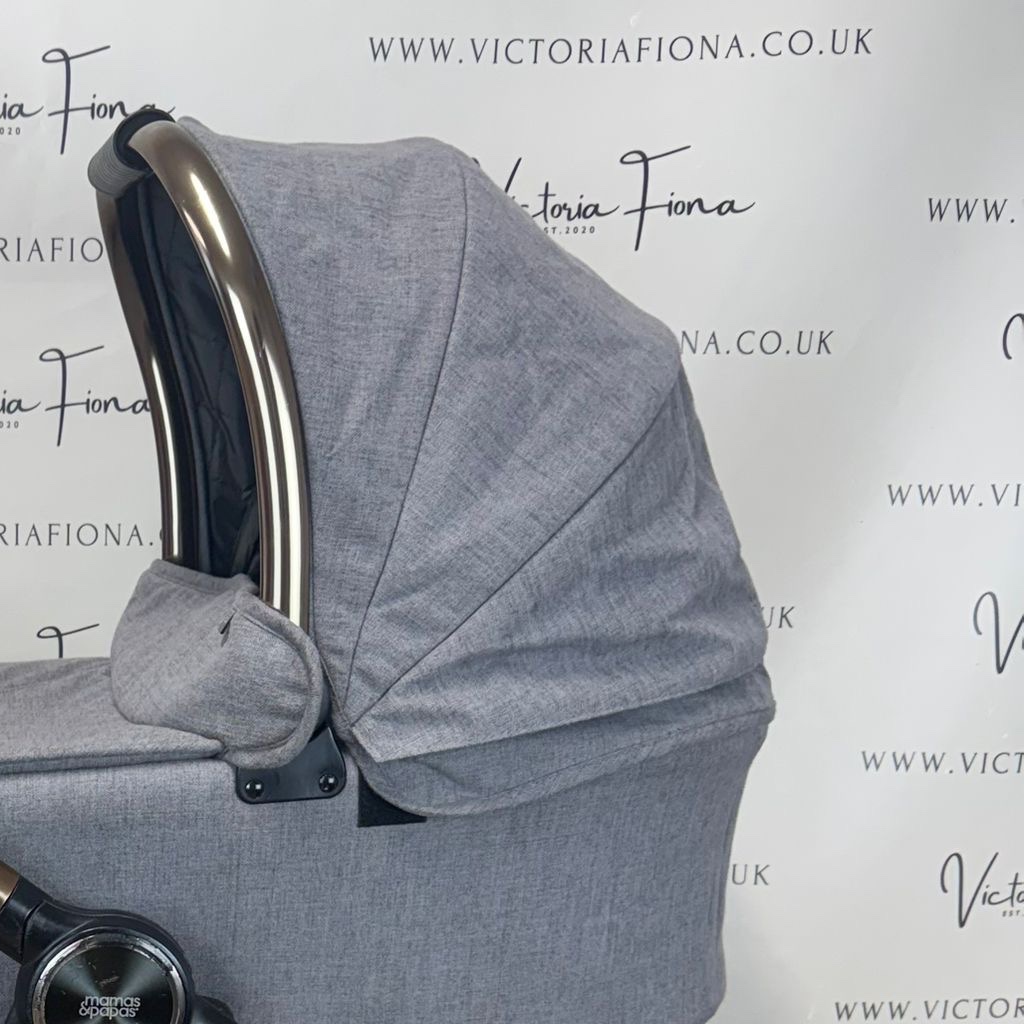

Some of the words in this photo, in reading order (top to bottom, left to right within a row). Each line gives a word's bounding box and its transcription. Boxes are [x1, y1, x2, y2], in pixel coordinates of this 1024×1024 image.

[369, 29, 873, 64] WWW.VICTORIAFIONA.CO.UK
[620, 145, 756, 251] Fiona
[544, 225, 596, 234] ST.2020
[39, 345, 151, 446] Fiona
[85, 996, 141, 1007] mamas
